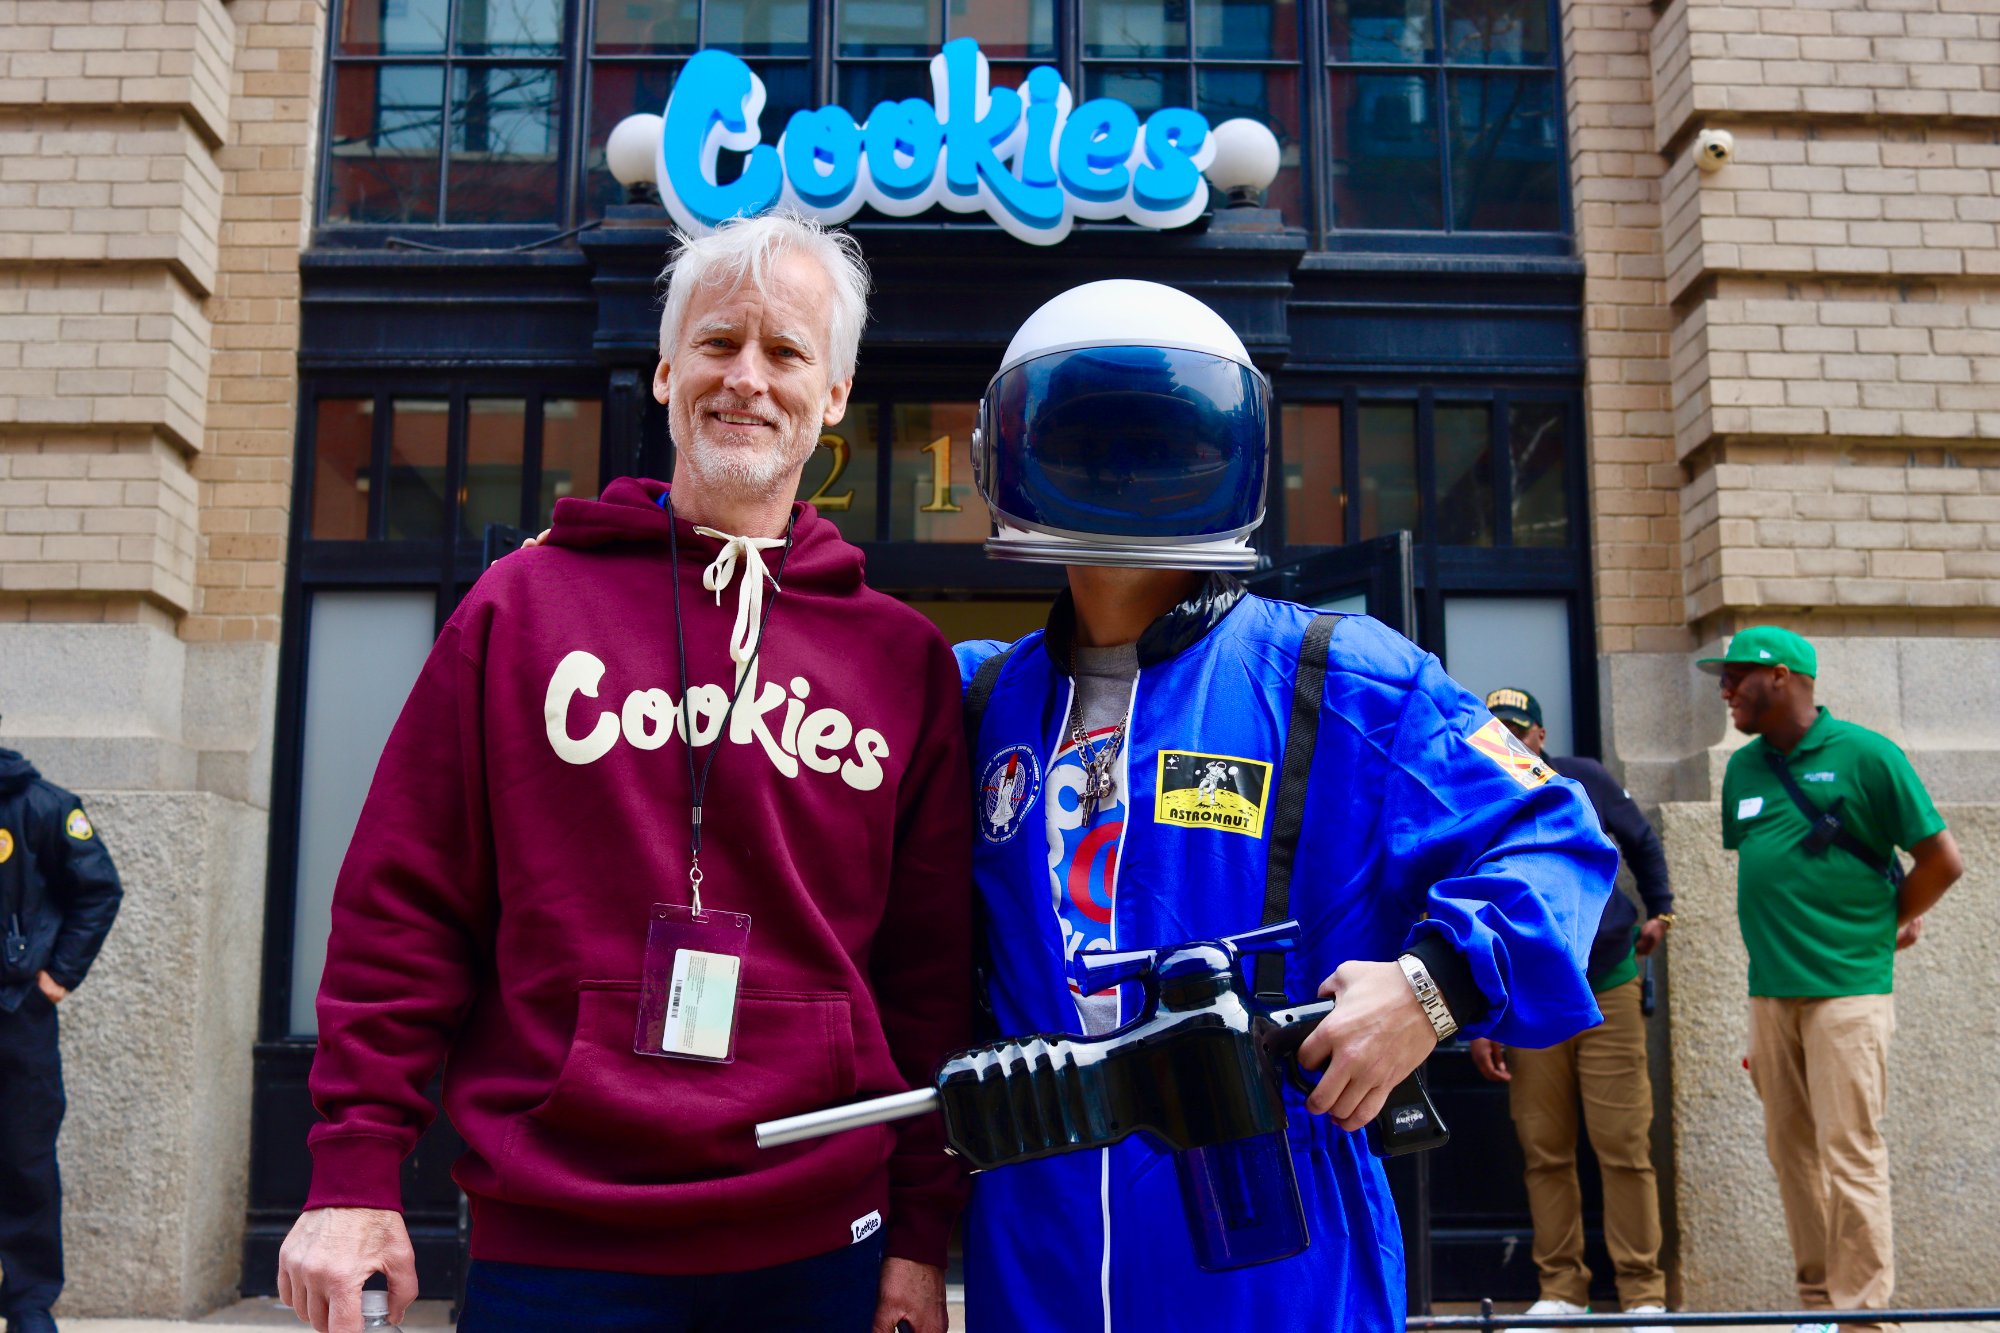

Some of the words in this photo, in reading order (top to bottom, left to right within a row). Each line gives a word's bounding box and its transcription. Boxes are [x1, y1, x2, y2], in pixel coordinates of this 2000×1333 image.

[658, 37, 1214, 244] Cookies
[807, 432, 854, 511] 2
[920, 434, 963, 512] 1
[544, 647, 889, 791] Cookies
[1169, 808, 1250, 828] ASTRONAUT
[855, 1218, 879, 1240] Cookies
